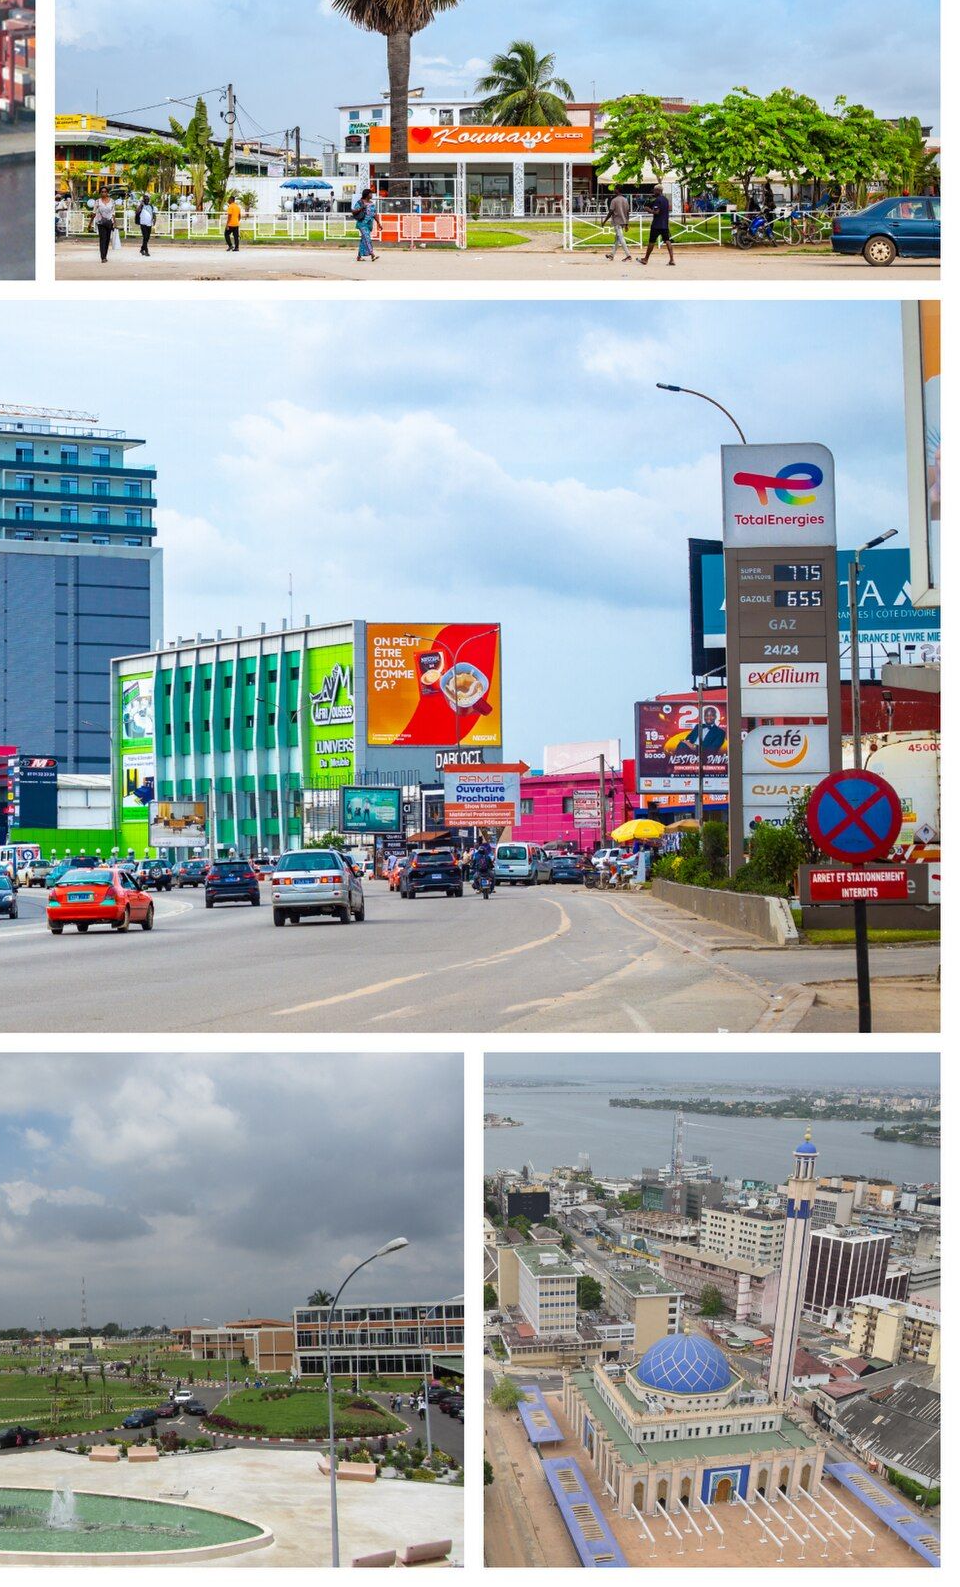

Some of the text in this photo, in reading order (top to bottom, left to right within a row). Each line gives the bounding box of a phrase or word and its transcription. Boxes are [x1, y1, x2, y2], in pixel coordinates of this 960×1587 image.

[433, 127, 554, 147] Koumassi
[734, 514, 824, 527] TotalEnergies
[788, 565, 821, 580] 775
[740, 591, 821, 607] GAZOLE 655
[769, 619, 797, 630] GAZ
[373, 637, 420, 646] ON PEUT
[891, 632, 901, 642] DE
[903, 632, 925, 642] VIVRE
[374, 647, 402, 657] ÊTRE
[763, 644, 800, 656] 24/24
[374, 659, 405, 668] DOUX
[374, 669, 414, 679] COMME
[748, 666, 820, 685] excellium
[374, 680, 389, 691] ÇA
[762, 729, 801, 747] café
[763, 747, 795, 756] bonjour
[456, 785, 505, 793] Ouverture
[456, 794, 505, 802] Prochaine
[812, 871, 905, 883] ARRET ET STATIONNEMENT
[841, 888, 878, 898] INTERDITS
